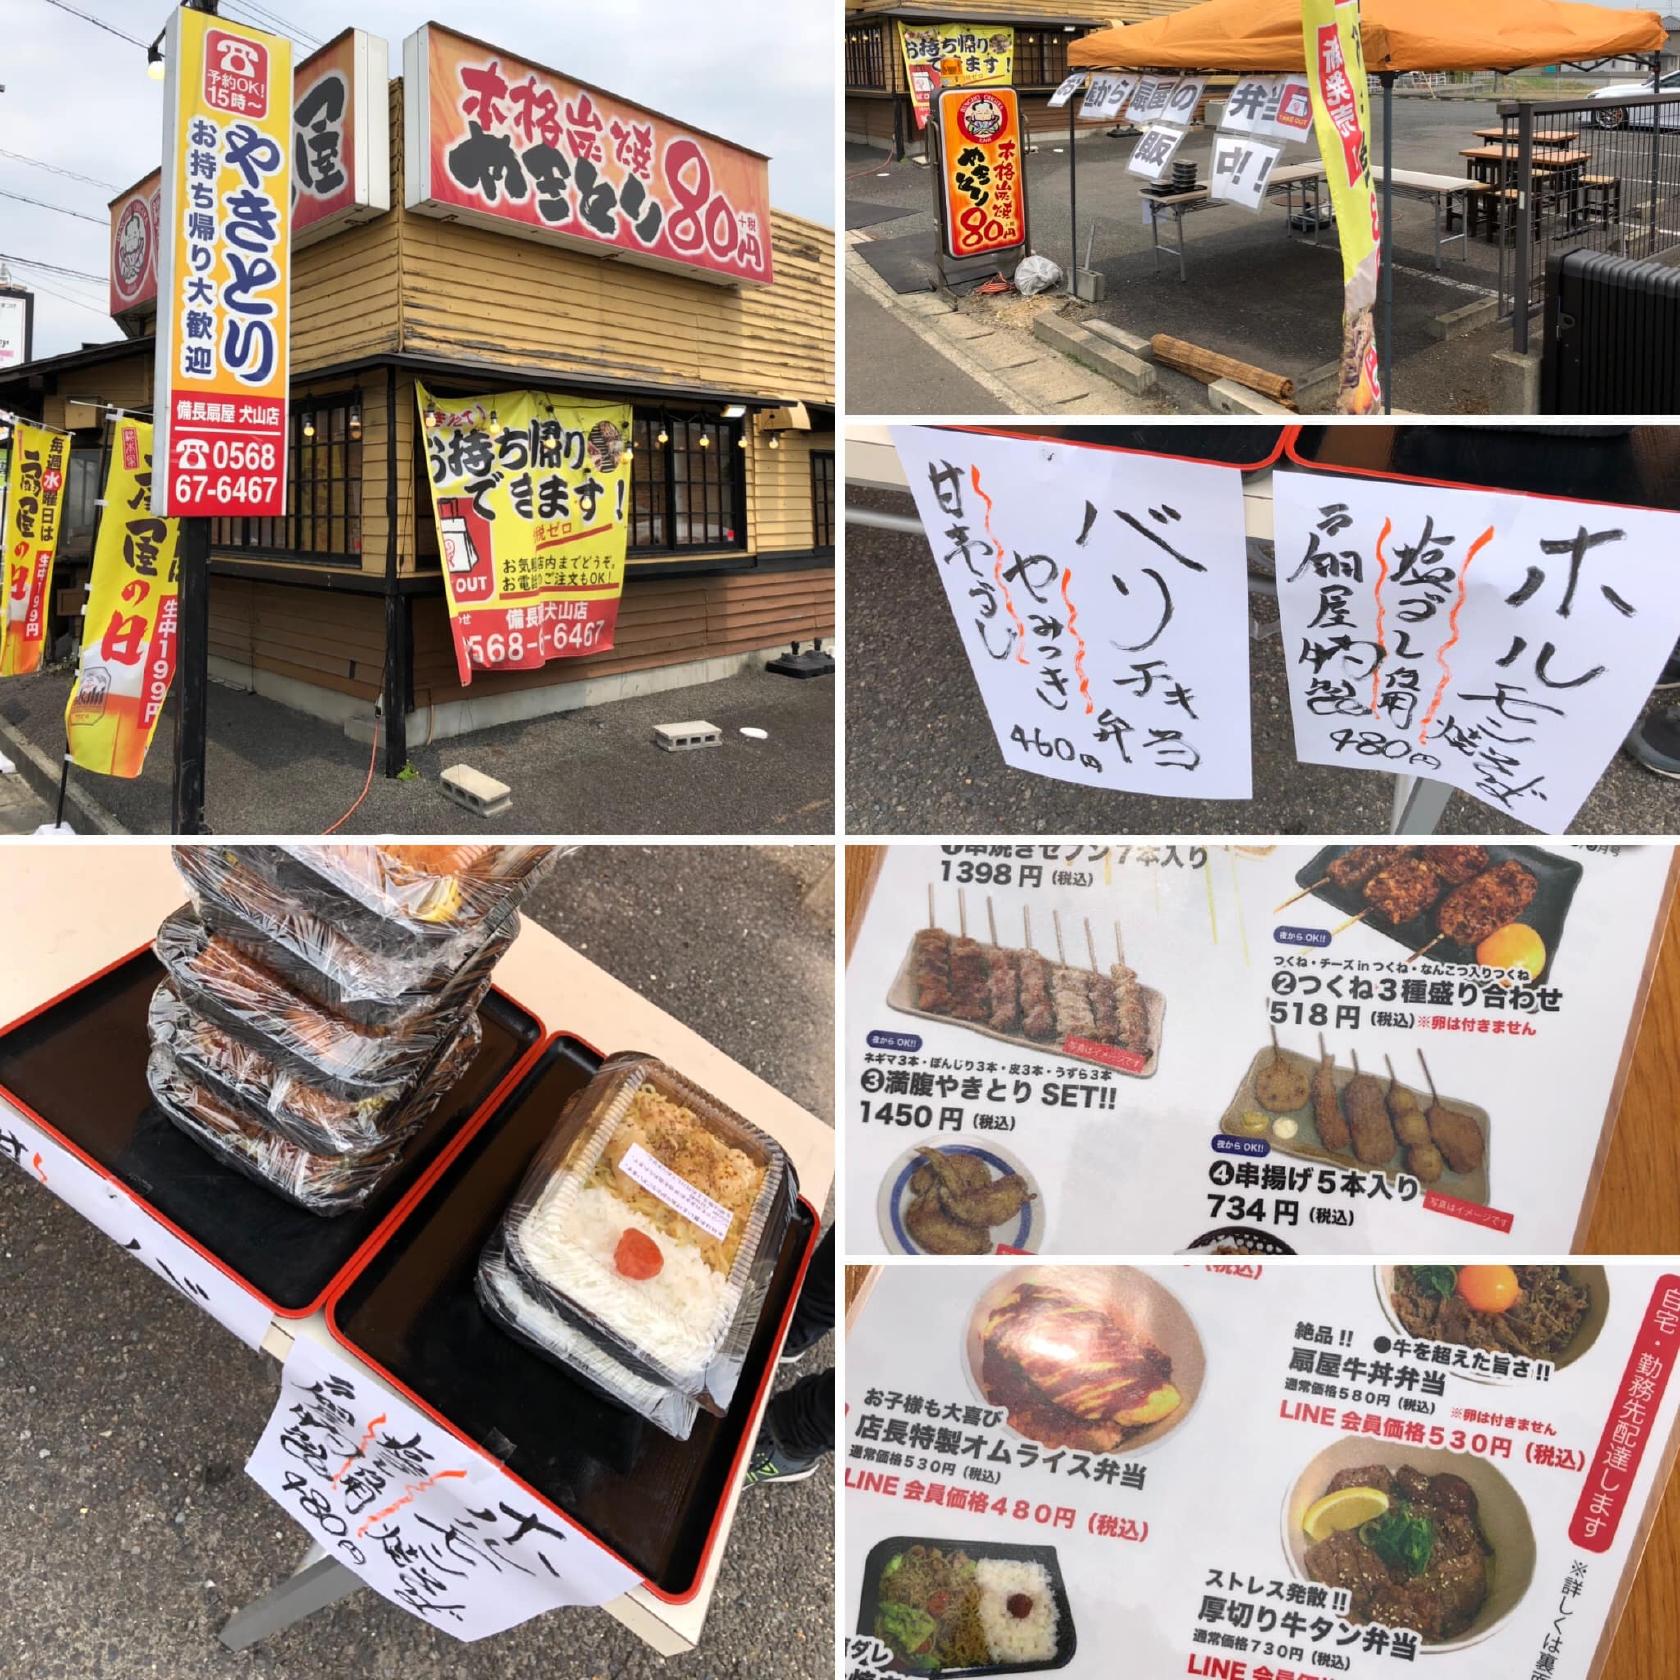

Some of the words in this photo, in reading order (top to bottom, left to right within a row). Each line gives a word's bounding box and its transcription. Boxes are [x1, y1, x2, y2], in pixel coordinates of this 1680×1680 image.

[207, 69, 264, 99] 予約OK!
[460, 61, 653, 180] 本格炭焼
[447, 119, 663, 244] やきとり
[954, 146, 992, 207] やきとり
[992, 139, 1015, 220] 本格炭焼
[184, 119, 218, 376] お持ち帰り大歓迎
[224, 124, 281, 383] やきとり
[176, 399, 236, 426] 備長扇屋
[239, 403, 281, 427] 犬山店
[212, 441, 276, 471] 0568
[40, 436, 64, 543] 毎週水曜日は
[174, 475, 279, 505] 67-6467
[10, 450, 43, 601] 扇屋の日
[455, 576, 487, 593] OUT
[1002, 550, 1069, 711] やみつき
[1009, 723, 1104, 774] 460円
[1328, 727, 1443, 770] 480円
[1288, 1346, 1448, 1397] 扇屋牛丼弁当
[863, 1387, 1004, 1429] お子様も大喜び
[1279, 1399, 1337, 1427] LINE
[854, 1413, 1147, 1491] 店長特製オムライス弁当
[845, 1467, 900, 1496] LINE
[1198, 1594, 1418, 1662] 厚切り牛タン弁当
[1187, 1653, 1248, 1680] LINE
